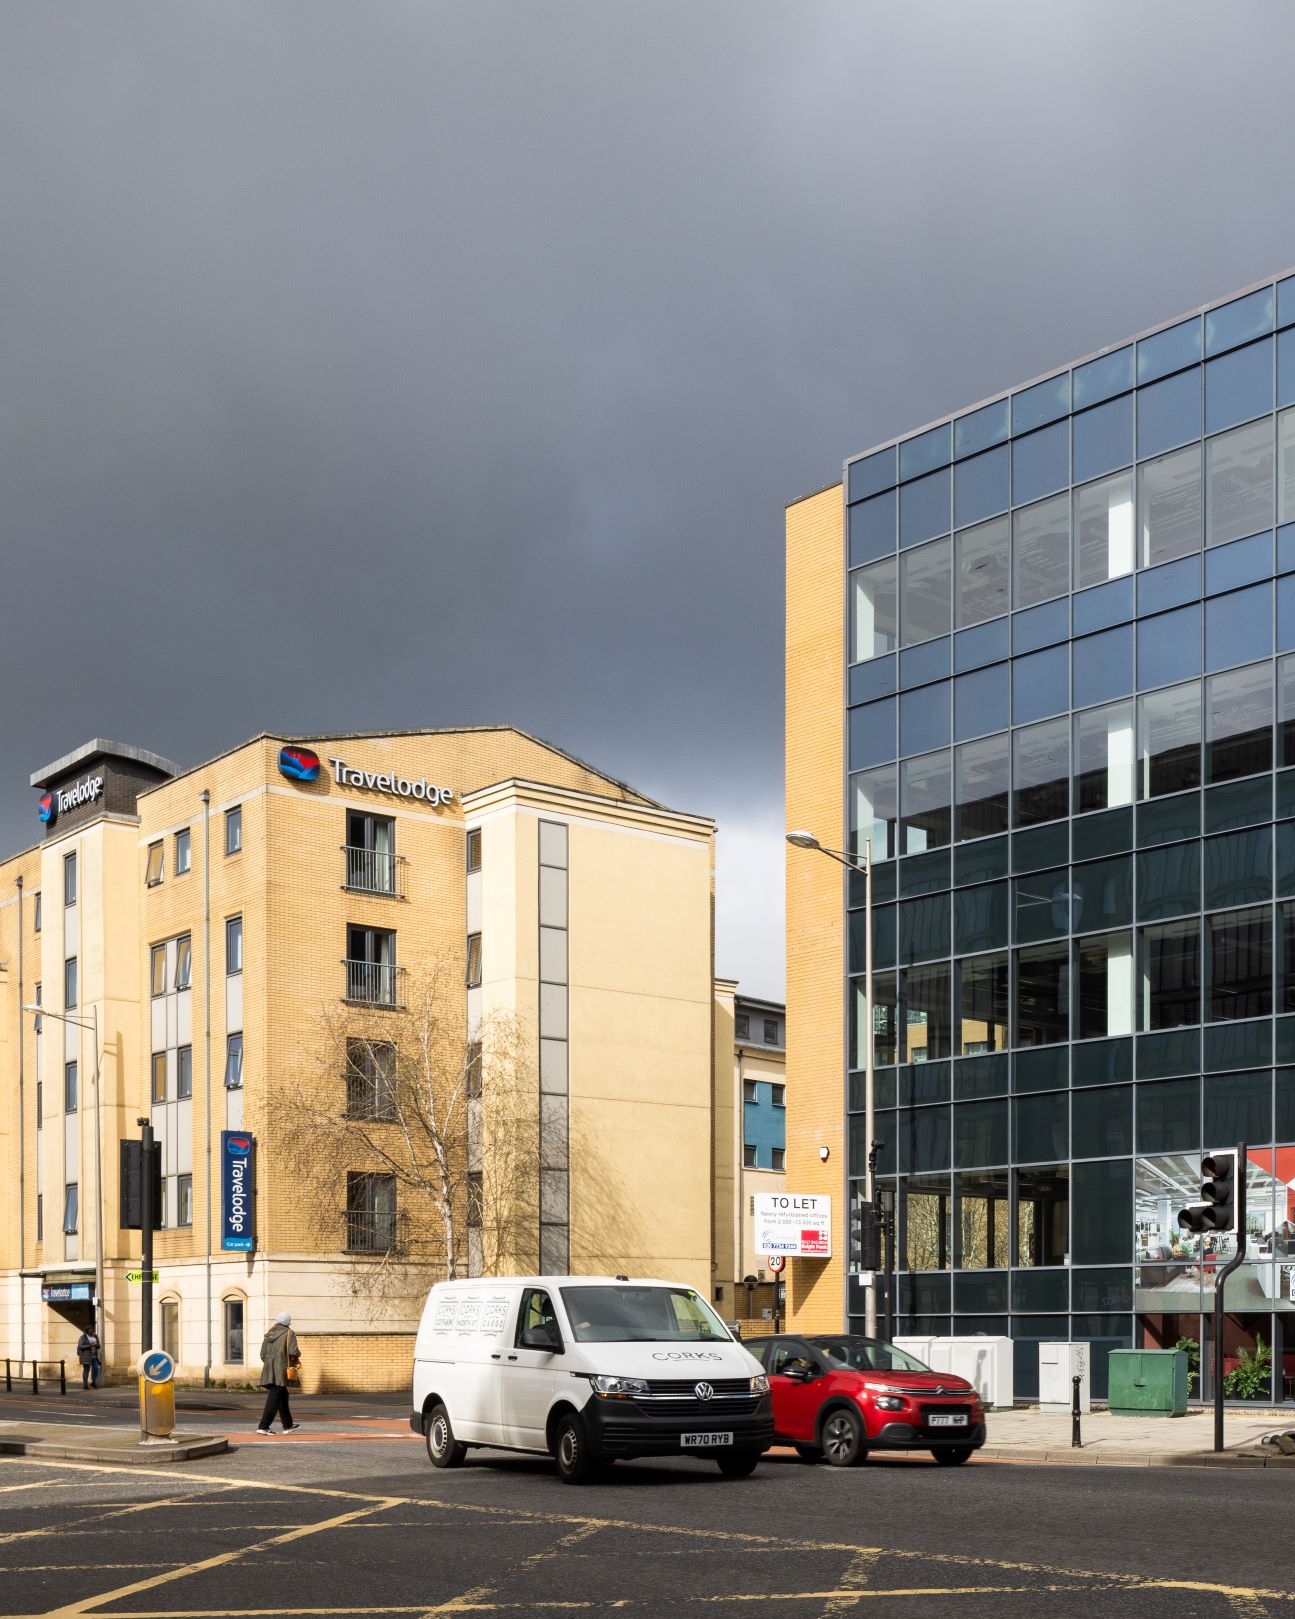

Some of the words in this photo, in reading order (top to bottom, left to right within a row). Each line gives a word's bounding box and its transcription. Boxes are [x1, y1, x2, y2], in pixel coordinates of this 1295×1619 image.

[329, 757, 454, 807] Travelodge
[56, 775, 103, 813] Travelodge
[229, 1157, 248, 1232] Travelodge
[771, 1197, 789, 1209] TO
[793, 1198, 817, 1210] LET
[770, 1256, 781, 1266] 20
[652, 1352, 722, 1361] CORKS
[684, 1434, 709, 1445] WR70
[711, 1433, 730, 1444] RYB
